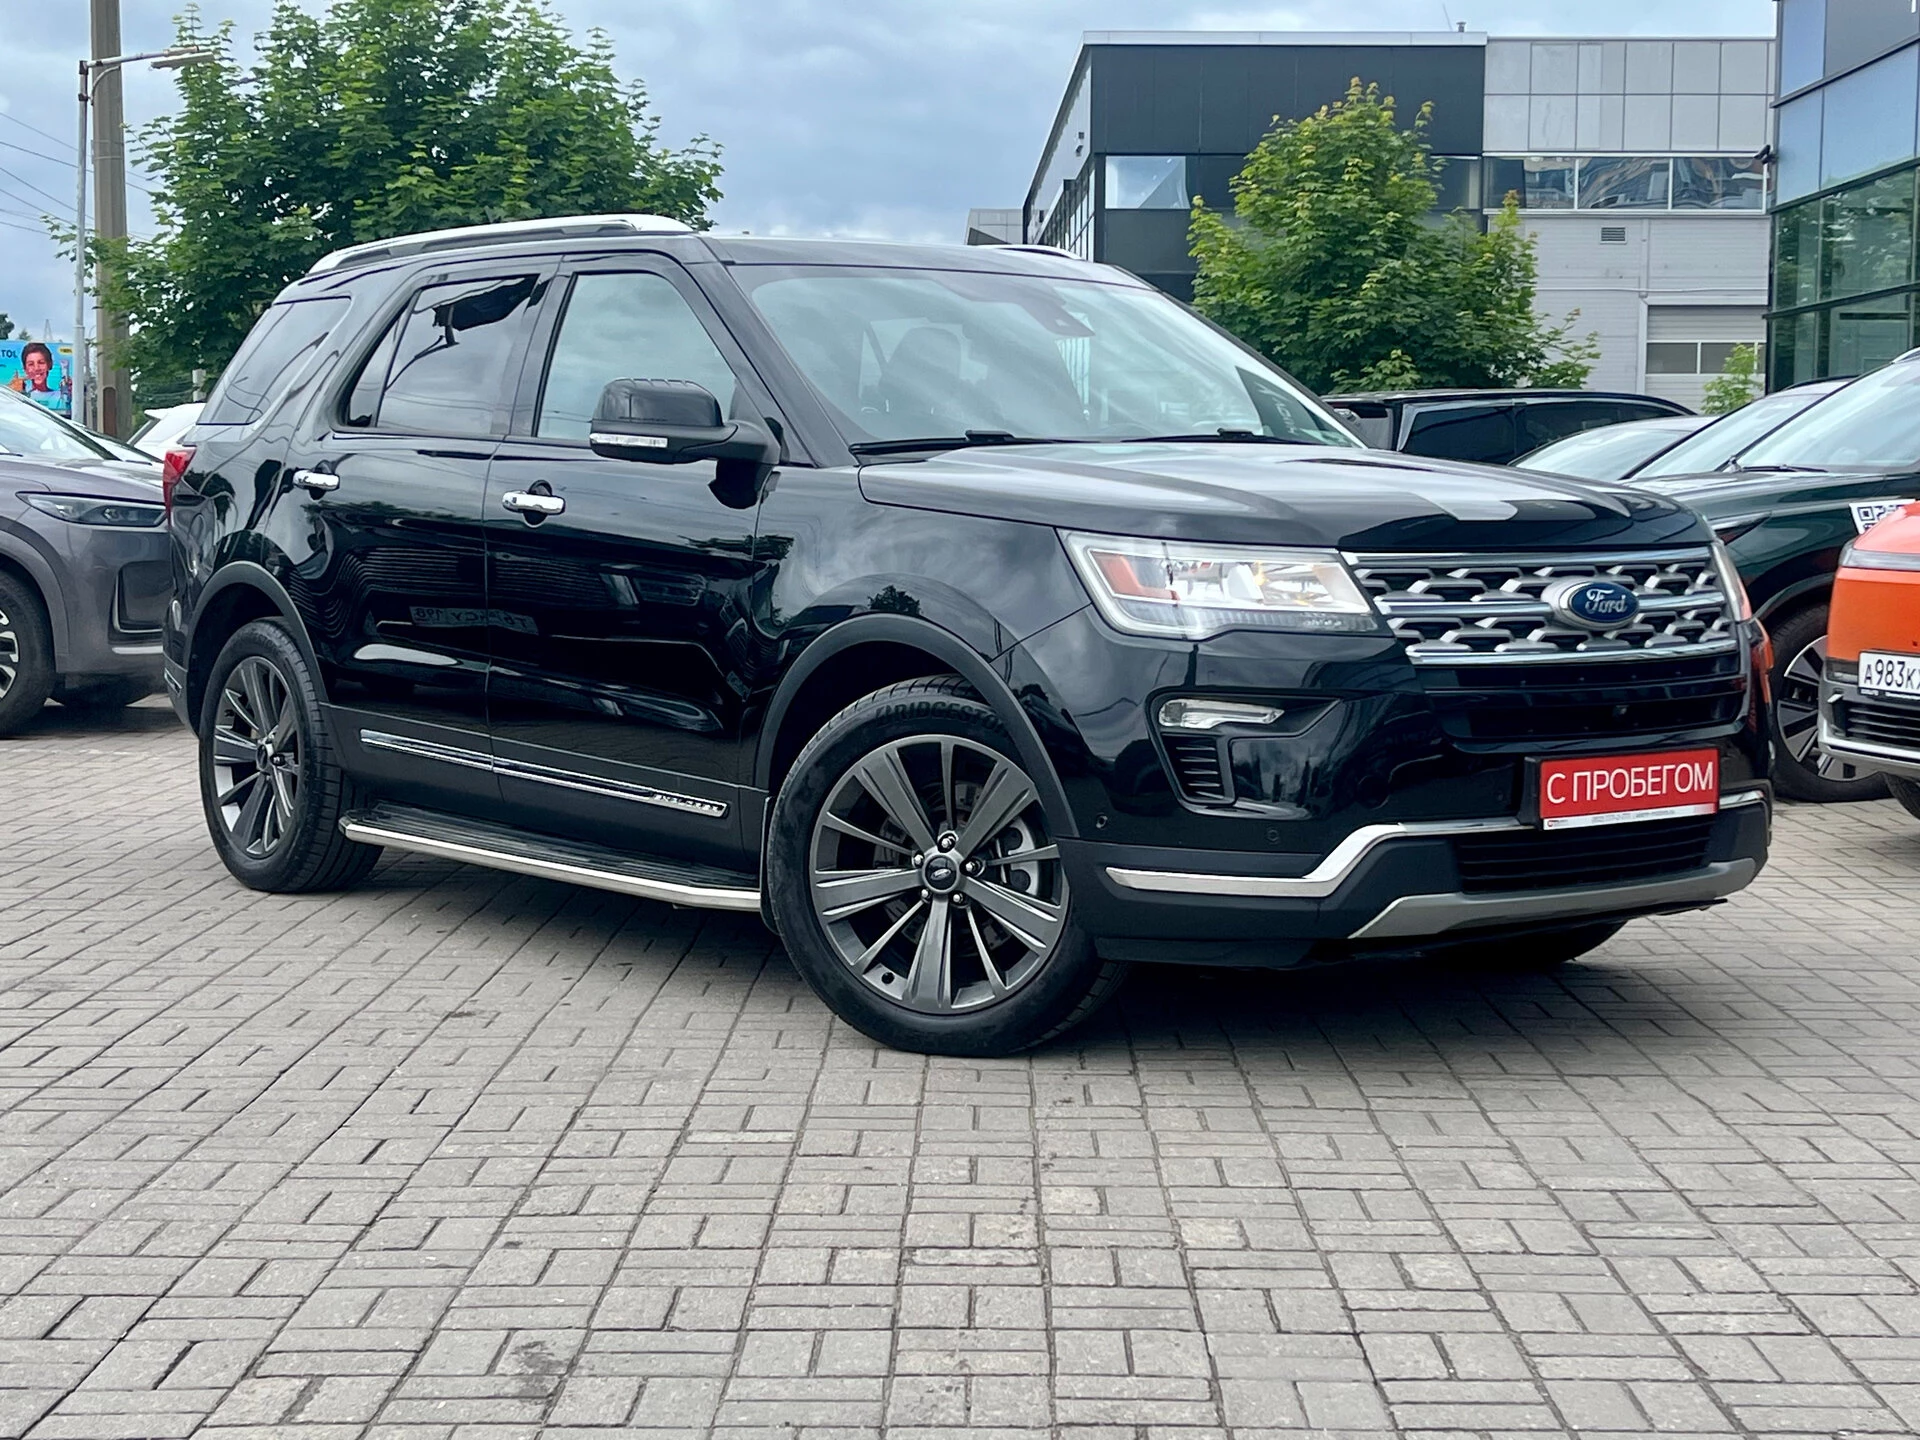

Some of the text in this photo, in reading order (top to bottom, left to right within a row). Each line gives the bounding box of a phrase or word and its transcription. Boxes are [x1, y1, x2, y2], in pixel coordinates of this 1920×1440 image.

[1585, 588, 1628, 614] Ford
[1547, 762, 1713, 804] С ПРОБЕГОМ
